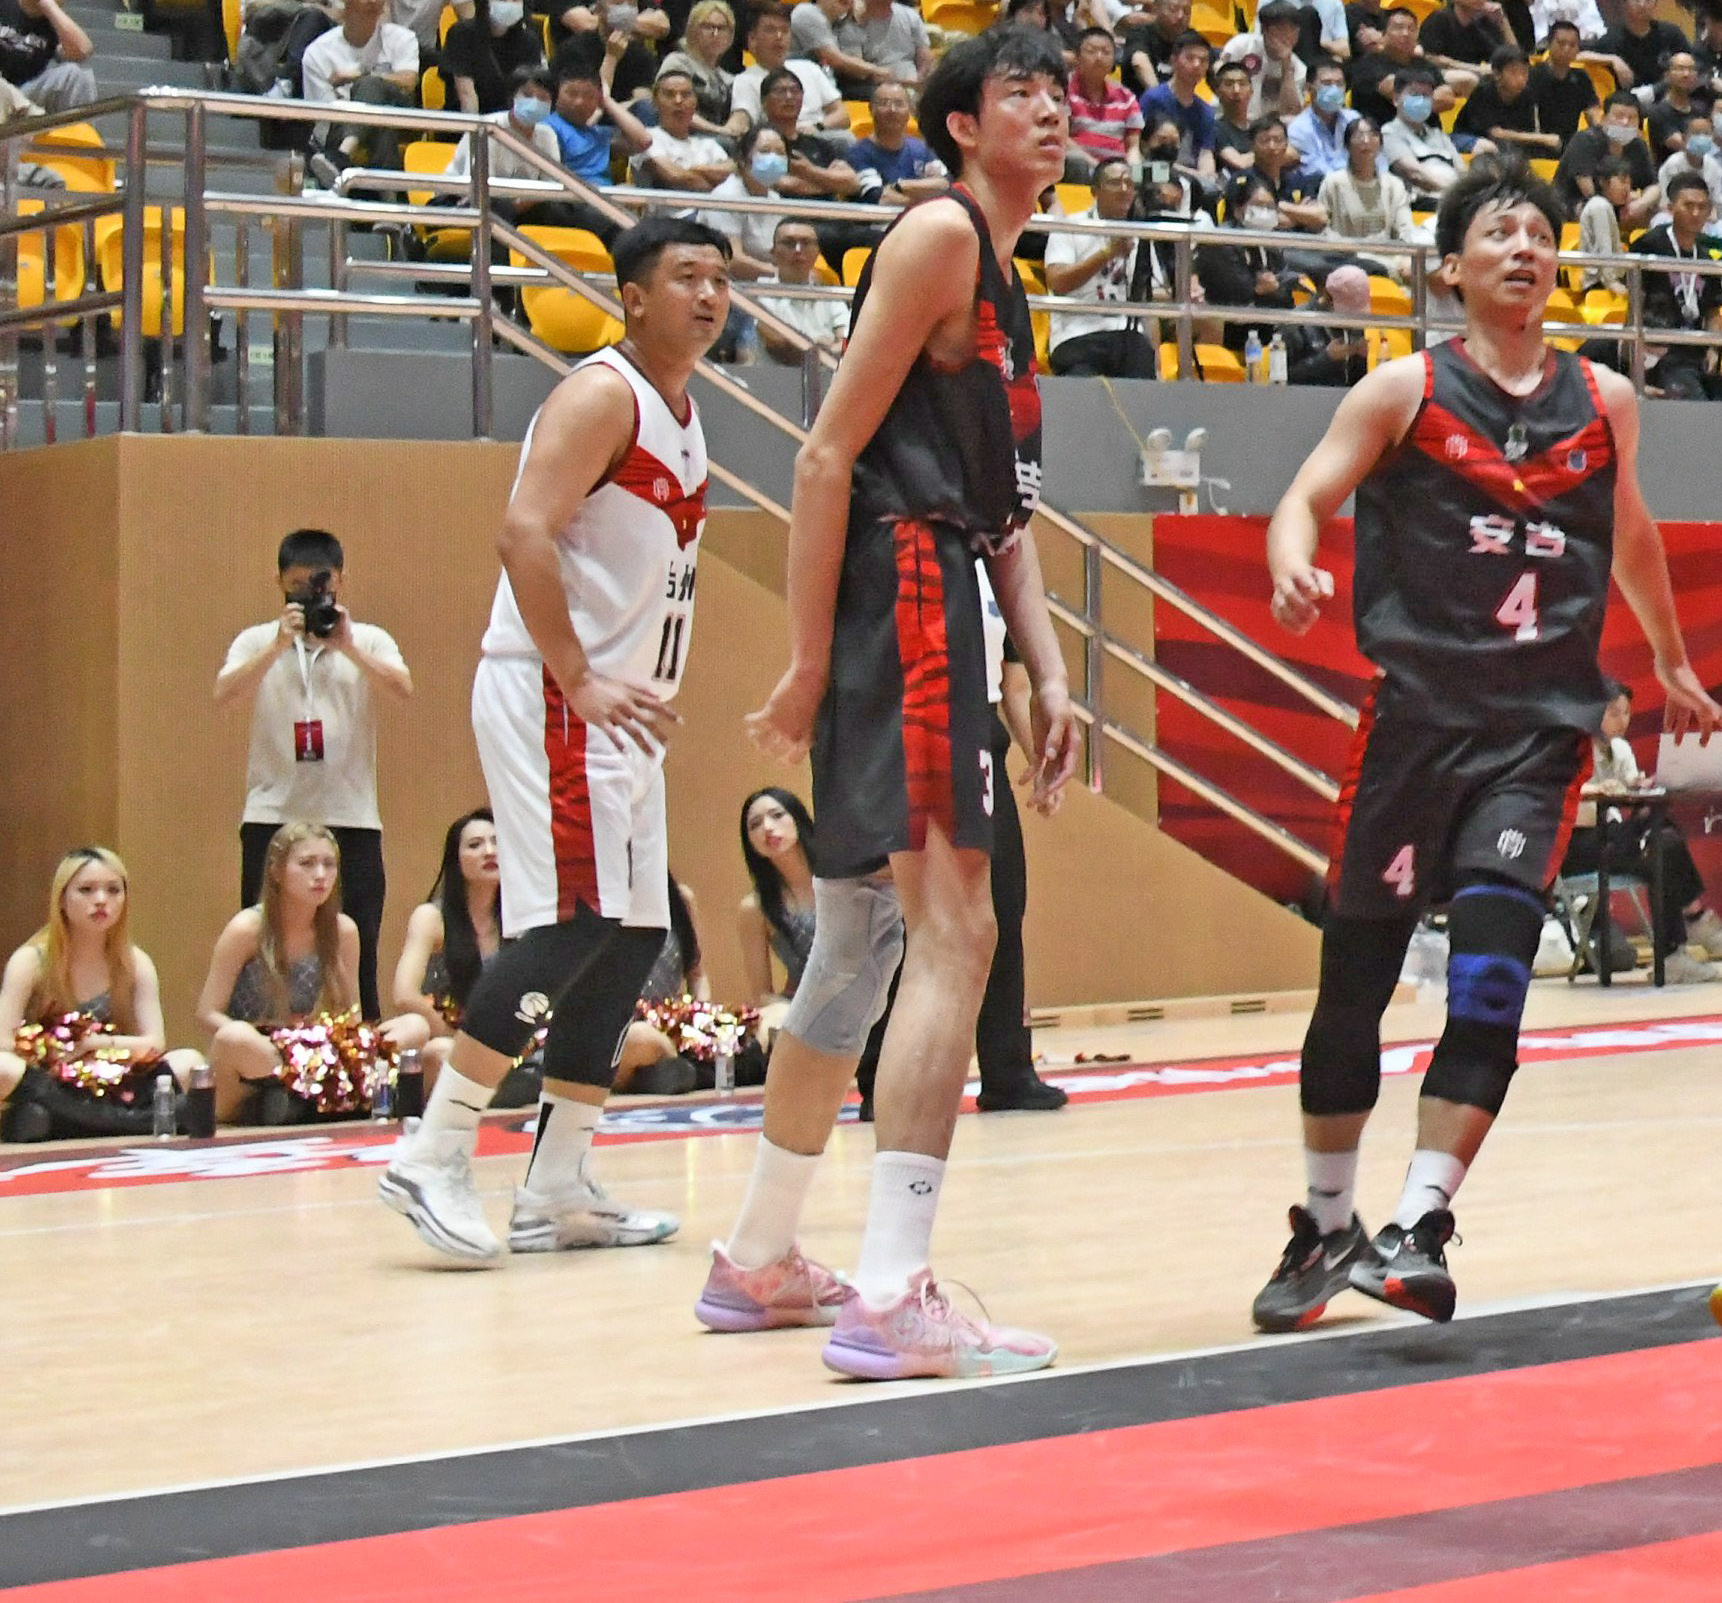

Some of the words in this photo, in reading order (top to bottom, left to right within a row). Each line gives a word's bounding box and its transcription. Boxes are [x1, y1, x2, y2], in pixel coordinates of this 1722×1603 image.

[1469, 514, 1567, 558] 安吉
[1495, 569, 1541, 643] 4
[651, 612, 686, 685] 11
[1382, 844, 1415, 897] 4
